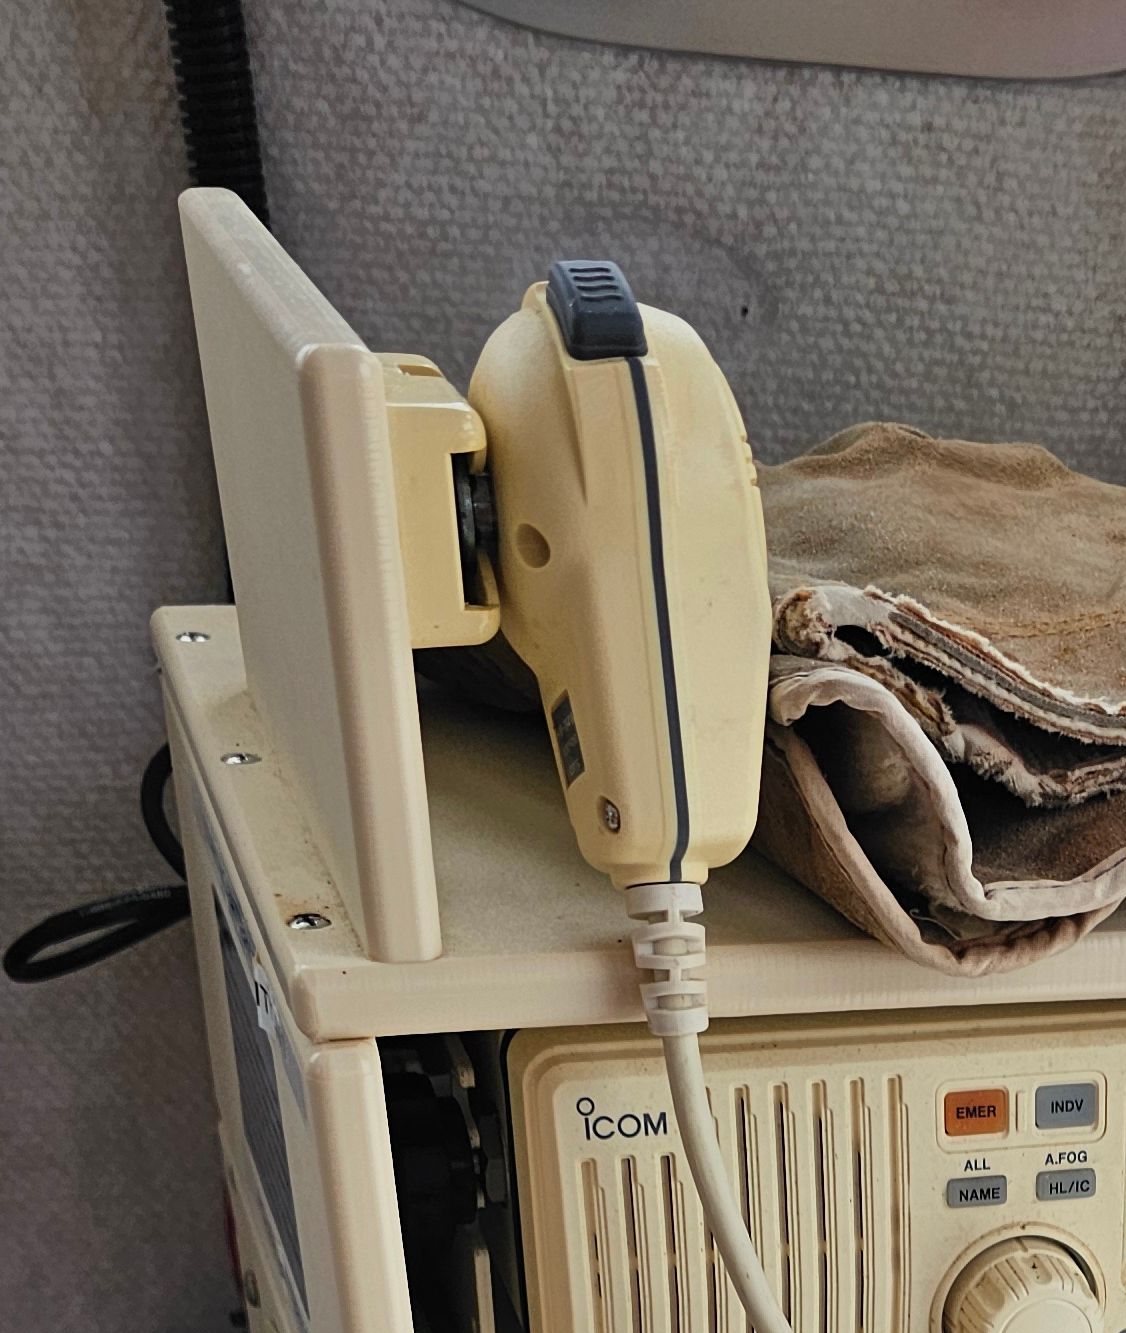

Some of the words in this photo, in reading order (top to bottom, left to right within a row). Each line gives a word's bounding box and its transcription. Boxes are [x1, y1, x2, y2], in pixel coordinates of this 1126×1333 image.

[956, 1105, 997, 1120] EMER
[1050, 1098, 1084, 1115] INDV
[964, 1158, 991, 1172] ALL
[1044, 1150, 1088, 1166] A.FOG
[959, 1187, 1000, 1202] NAME
[1049, 1179, 1090, 1195] HL/IC
